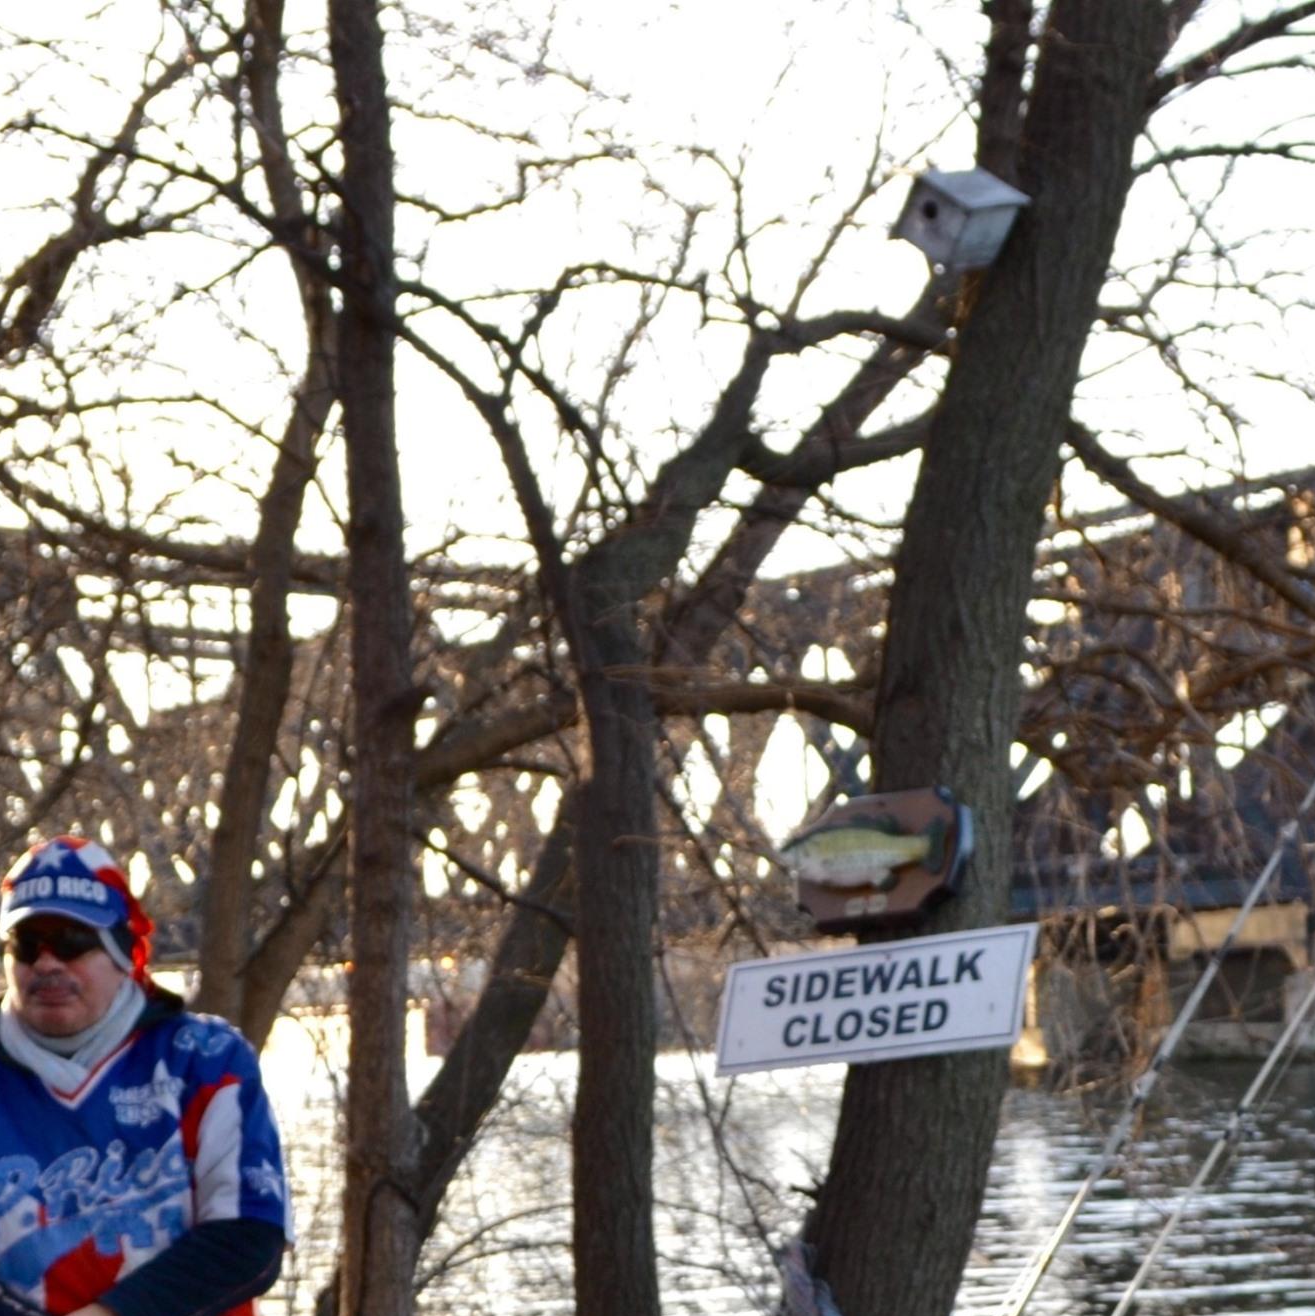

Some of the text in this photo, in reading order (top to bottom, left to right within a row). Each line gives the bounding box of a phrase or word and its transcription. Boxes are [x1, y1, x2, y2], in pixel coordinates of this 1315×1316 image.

[56, 875, 109, 904] RICO
[763, 949, 986, 1009] SIDEWALK
[782, 998, 950, 1048] CLOSED
